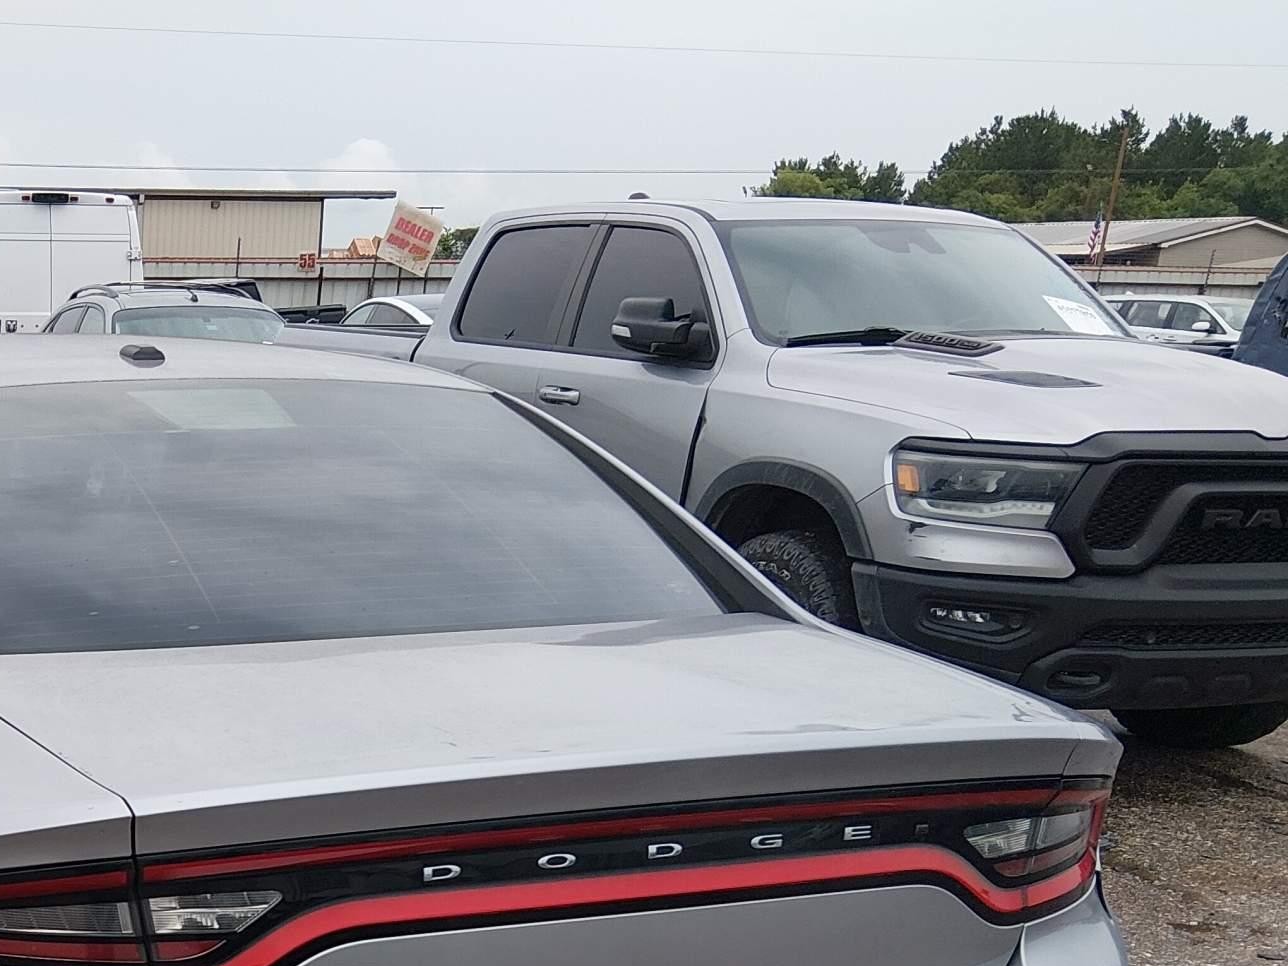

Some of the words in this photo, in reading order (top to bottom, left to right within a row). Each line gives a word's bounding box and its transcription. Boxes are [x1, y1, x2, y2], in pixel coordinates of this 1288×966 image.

[395, 217, 435, 244] DEALER
[300, 253, 316, 268] 55
[1201, 508, 1288, 529] RA
[423, 824, 873, 883] DODGE
